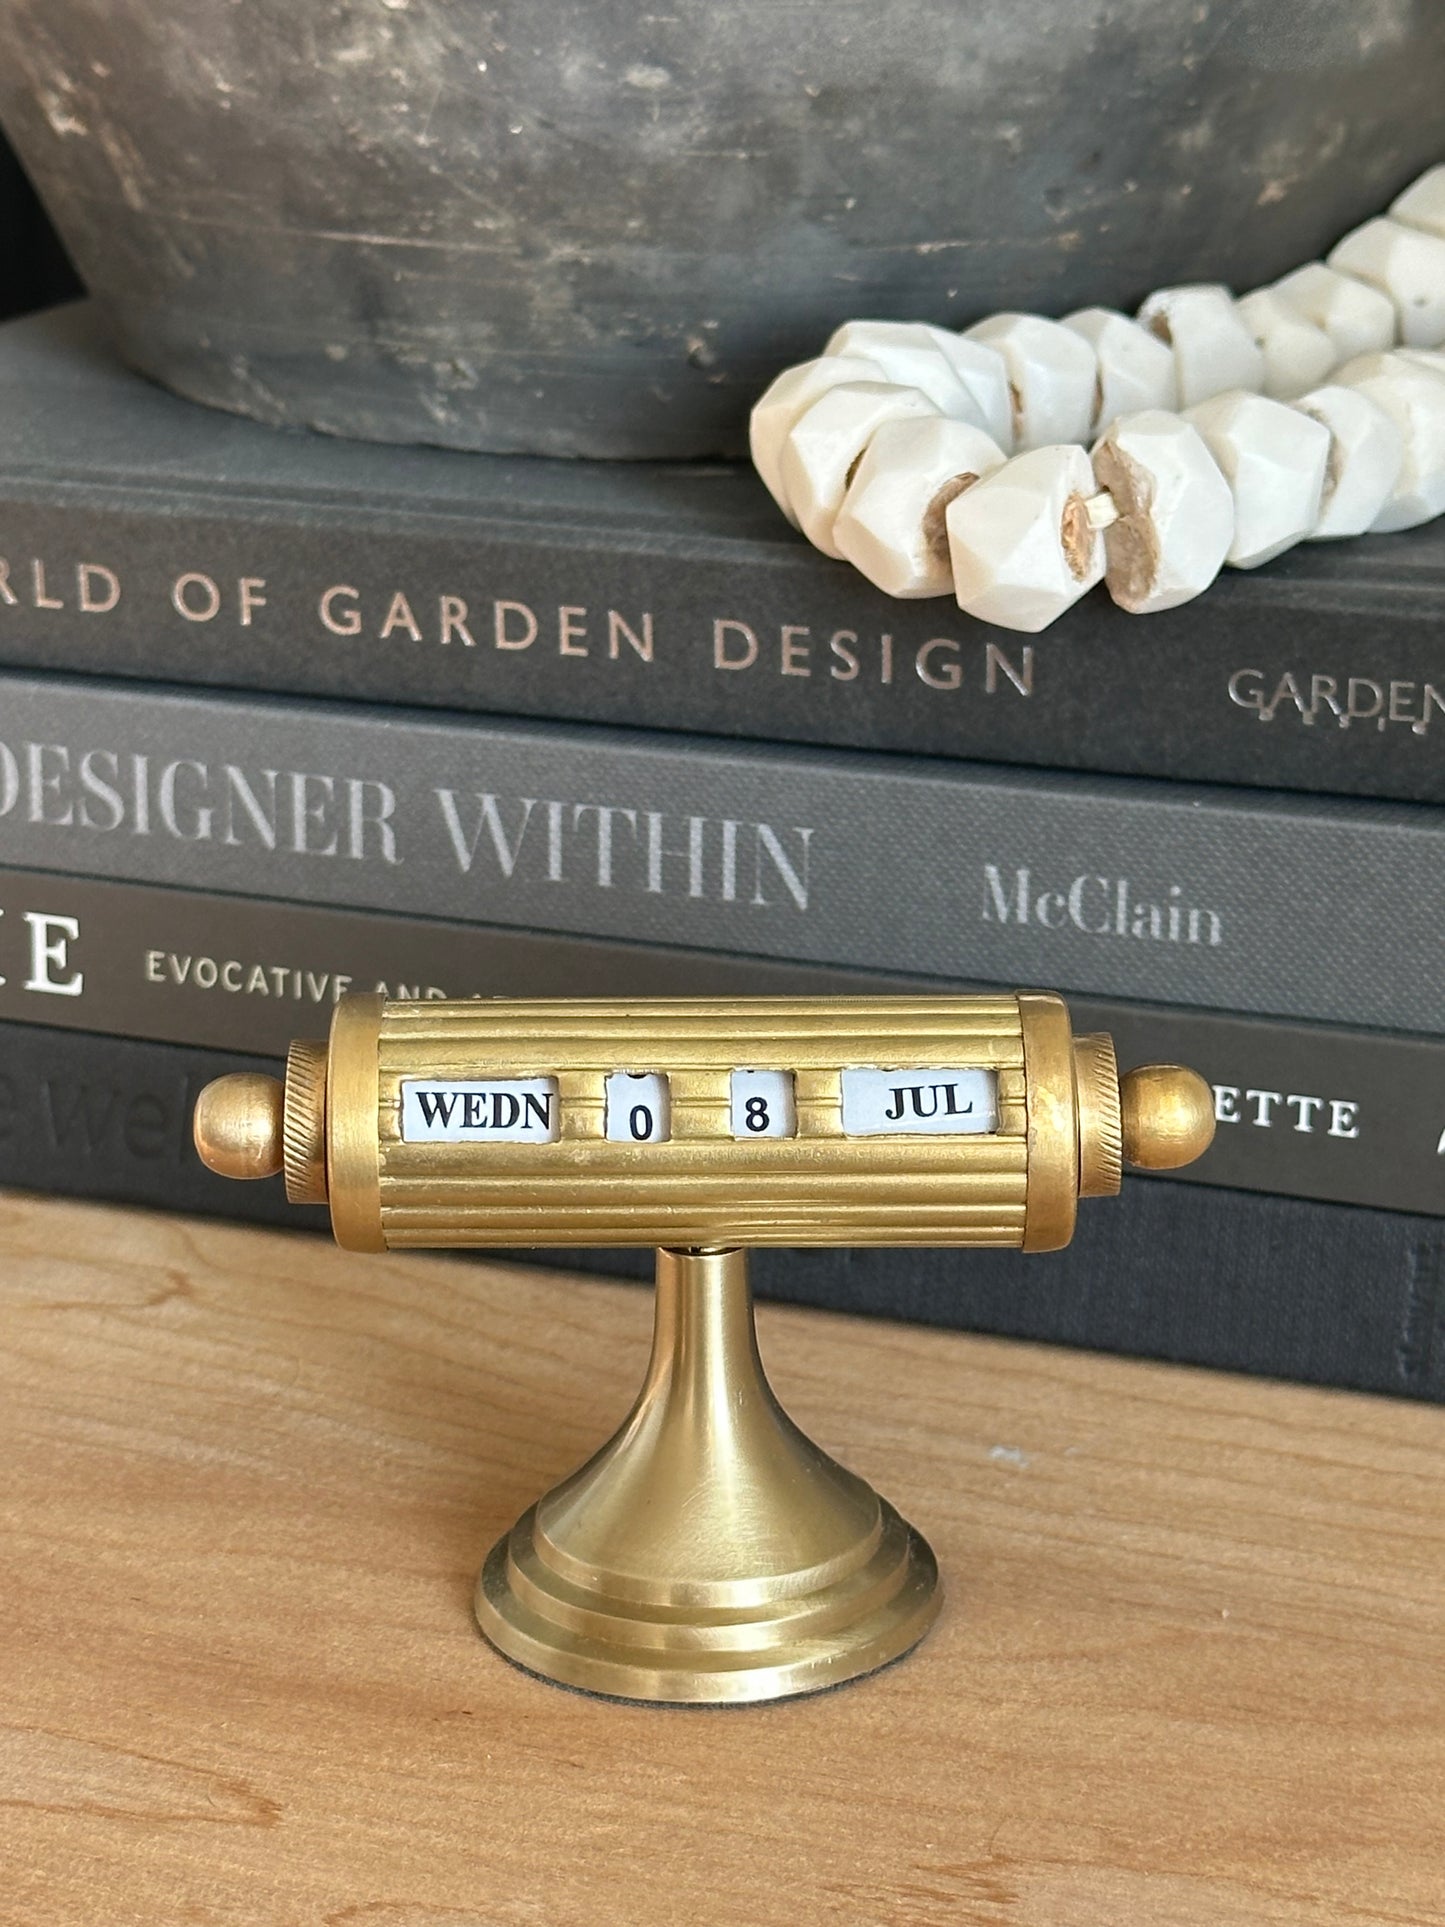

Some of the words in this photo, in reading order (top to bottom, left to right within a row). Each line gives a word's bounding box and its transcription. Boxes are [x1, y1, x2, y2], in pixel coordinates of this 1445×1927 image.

[172, 571, 268, 626] OF
[317, 583, 656, 663] GARDEN
[711, 617, 1036, 697] DESIGN
[433, 787, 815, 911] WITHIN
[982, 863, 1222, 947] McClain
[415, 1090, 555, 1132] WEDN
[628, 1103, 654, 1141] 0
[744, 1096, 771, 1133] 8
[885, 1082, 974, 1121] JUL
